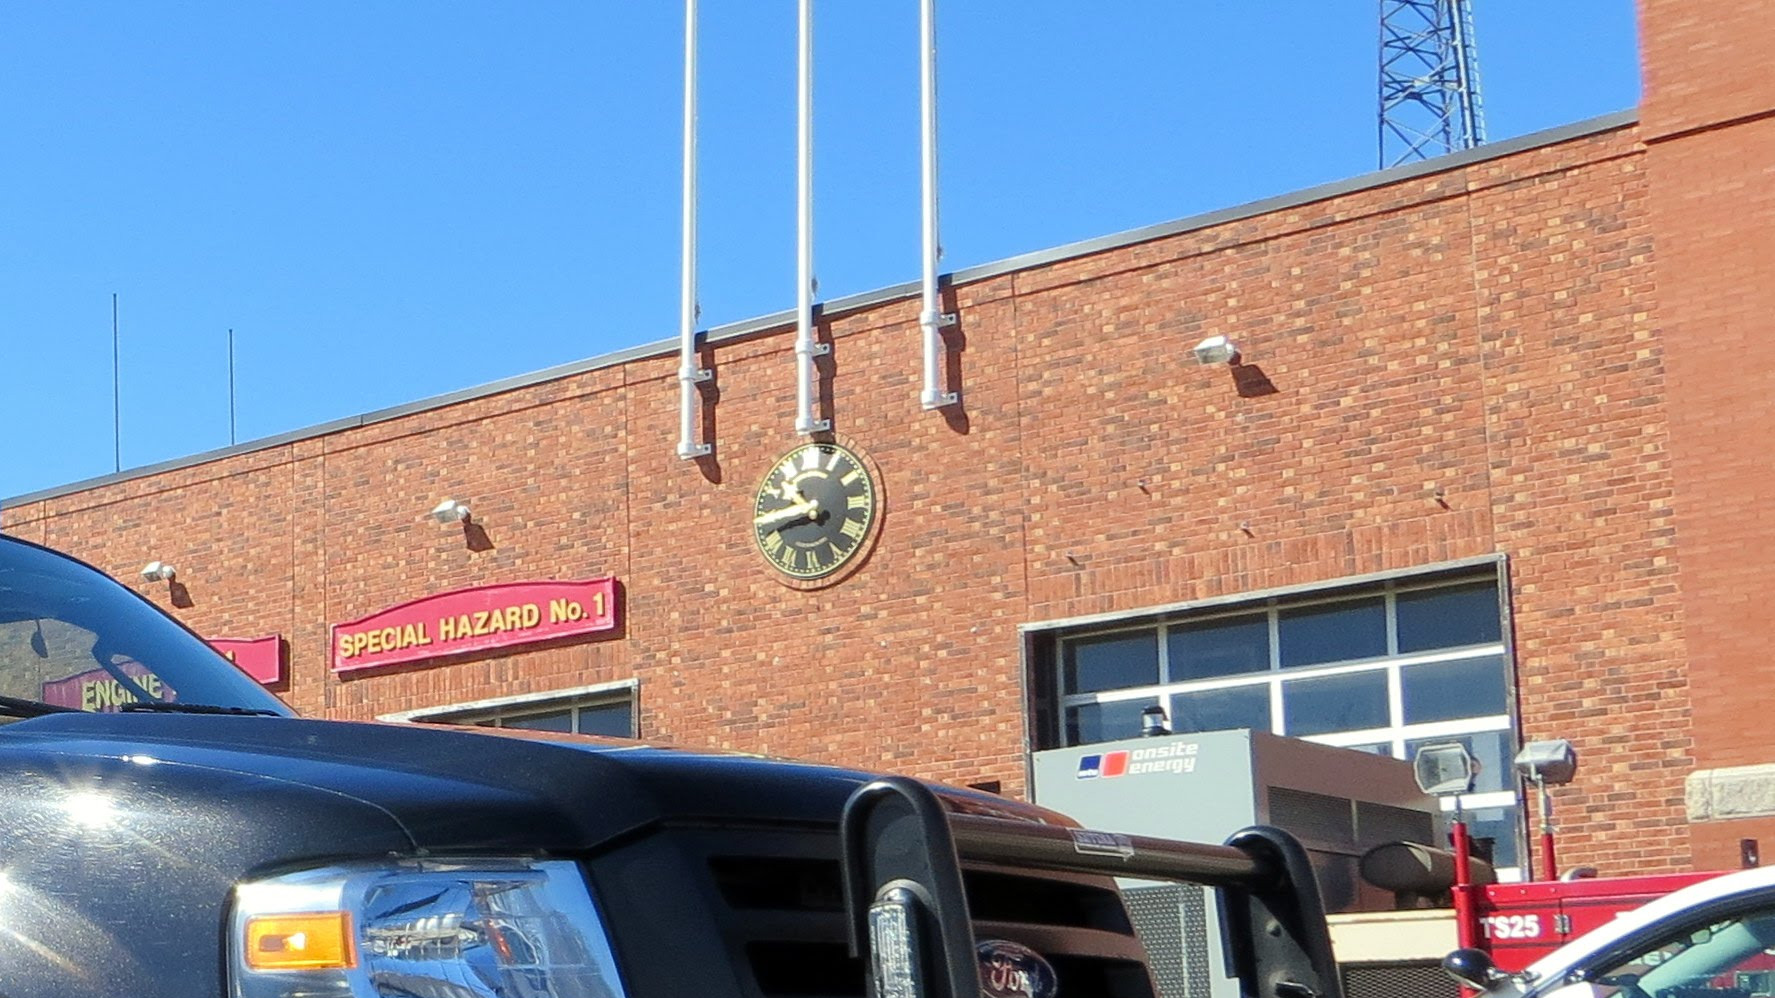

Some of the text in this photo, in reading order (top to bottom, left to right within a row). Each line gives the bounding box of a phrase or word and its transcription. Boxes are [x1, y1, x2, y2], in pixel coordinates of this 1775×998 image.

[339, 591, 606, 659] SPECIAL HAZARD No. 1
[1132, 742, 1199, 761] onsite
[1128, 757, 1197, 775] energy
[1479, 914, 1541, 939] TS25
